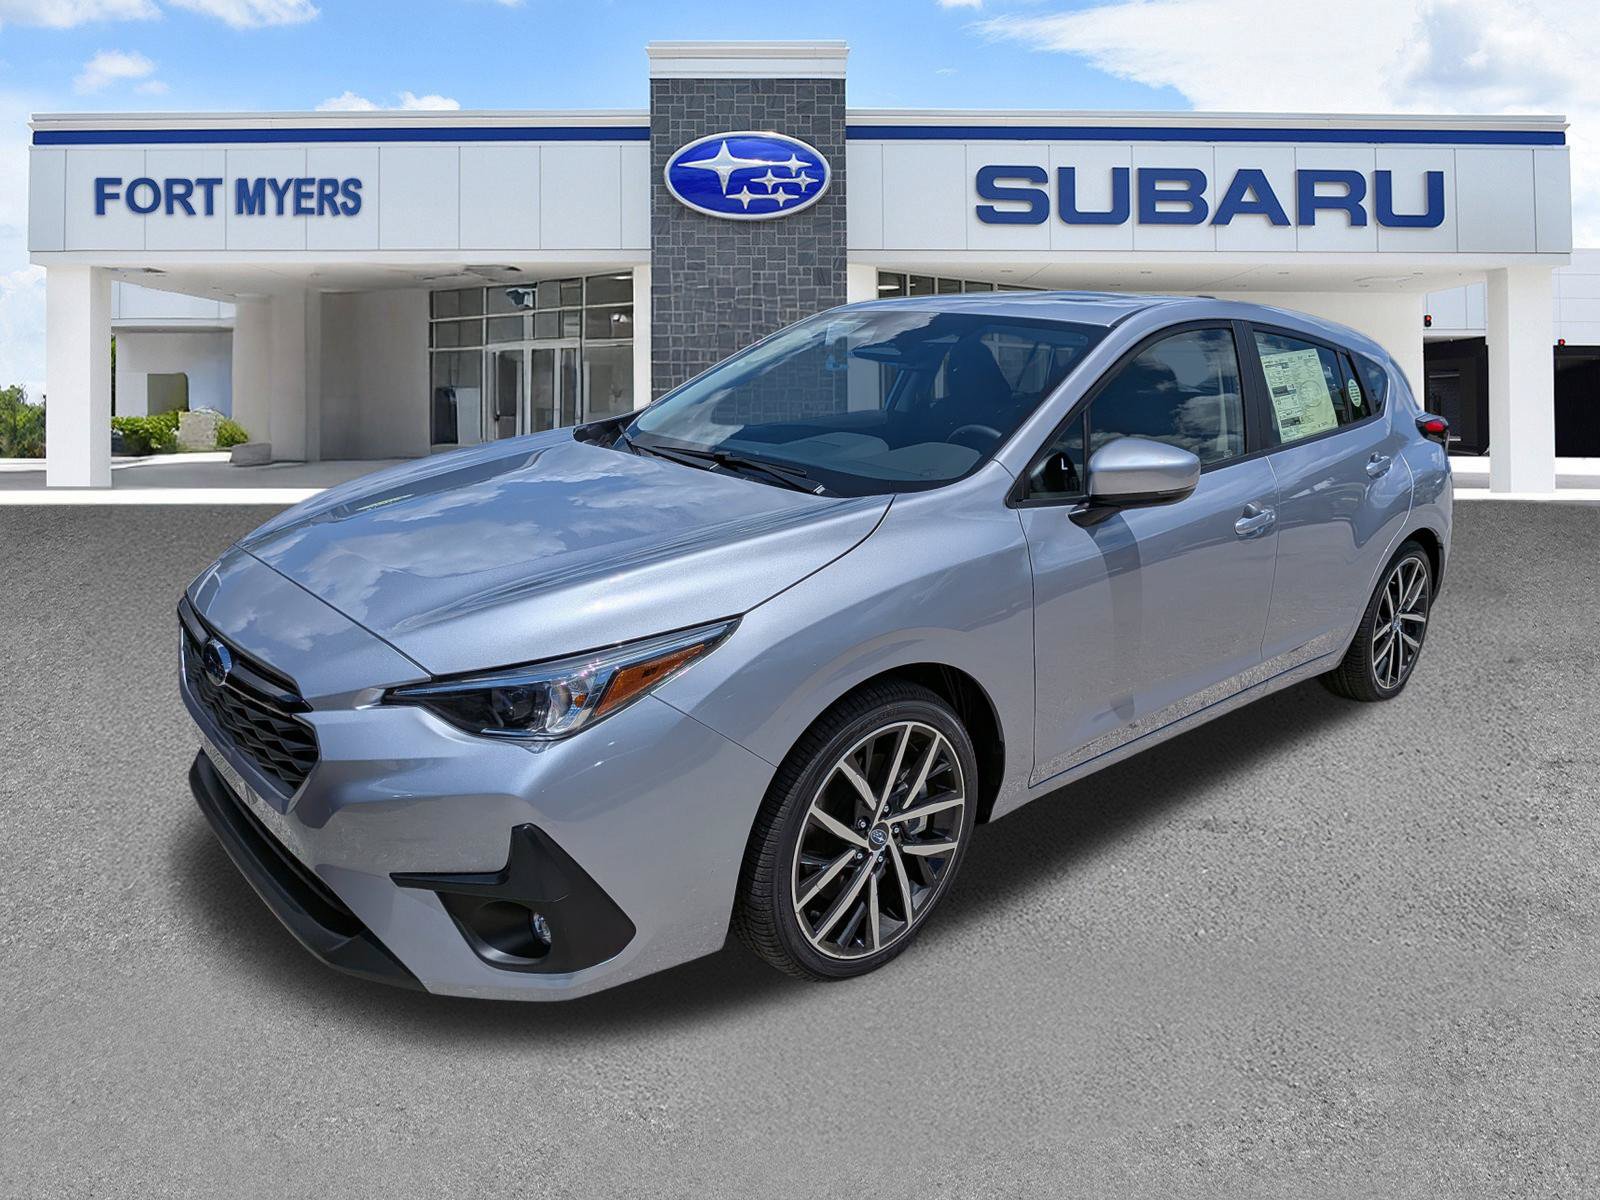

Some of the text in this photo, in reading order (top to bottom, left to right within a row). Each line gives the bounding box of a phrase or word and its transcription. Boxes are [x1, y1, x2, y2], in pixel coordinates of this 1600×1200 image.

[95, 177, 363, 217] FORT MYERS
[976, 165, 1446, 228] SUBARU
